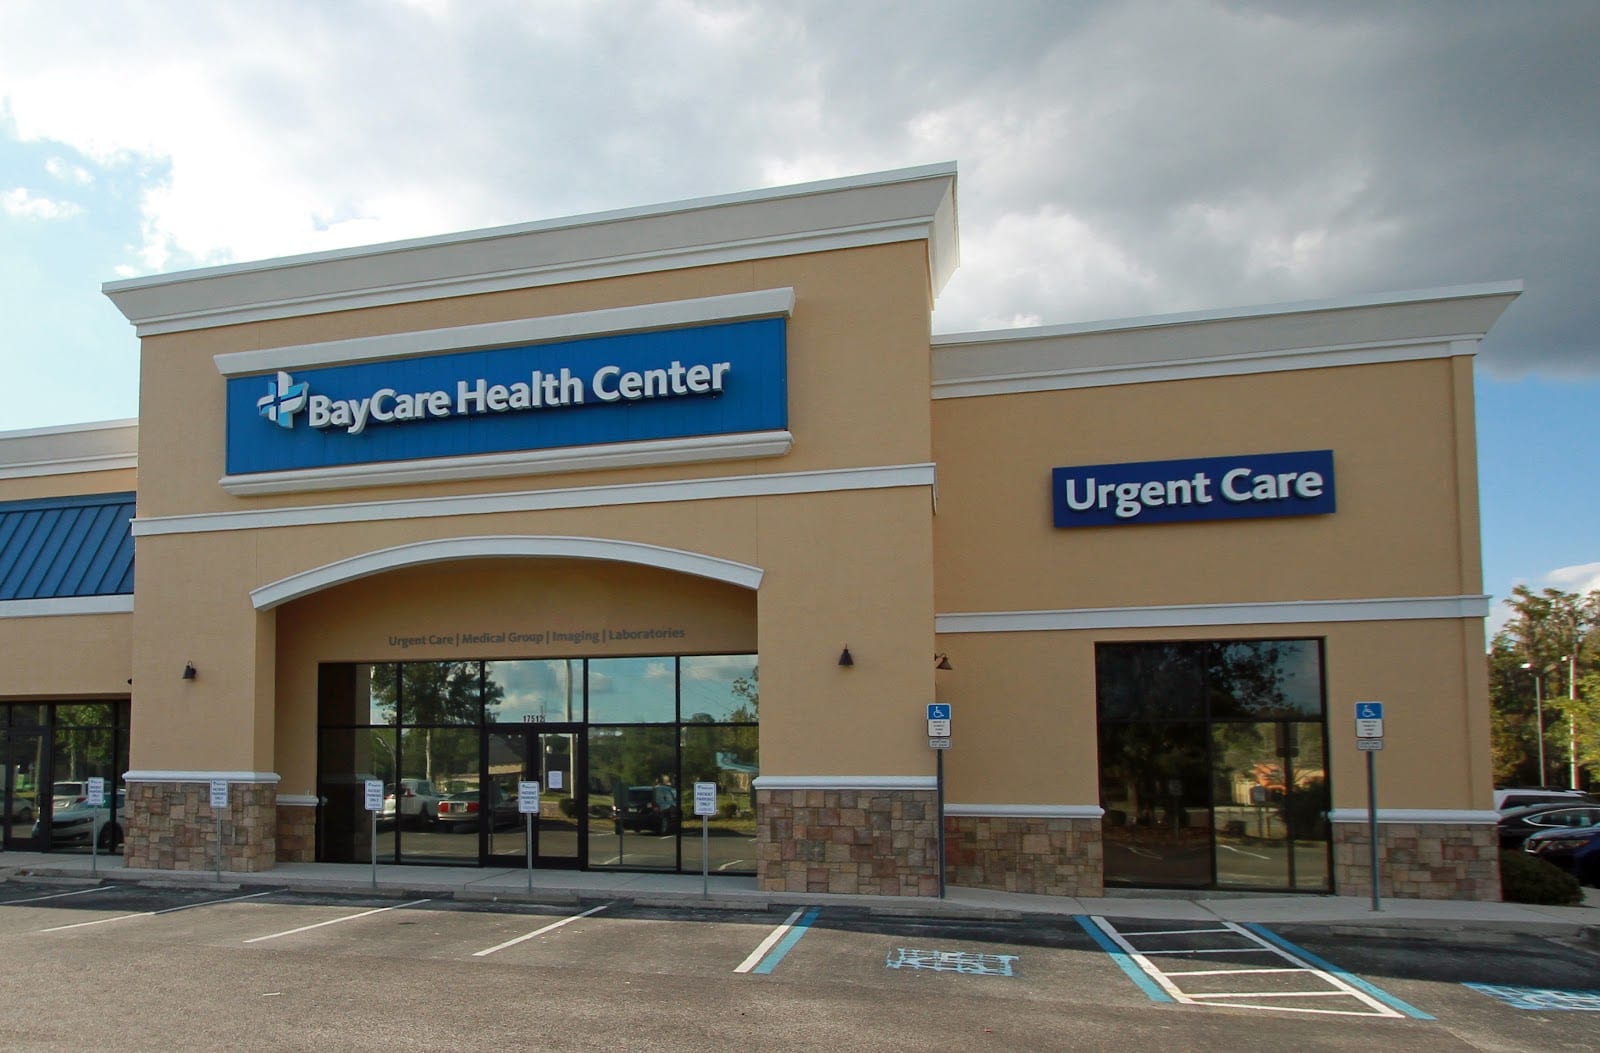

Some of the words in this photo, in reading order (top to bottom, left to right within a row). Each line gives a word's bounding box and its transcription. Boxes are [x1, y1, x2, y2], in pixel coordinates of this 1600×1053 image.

[308, 387, 451, 434] BayCare
[456, 367, 583, 415] Health
[592, 360, 730, 402] Center
[1066, 472, 1212, 518] Urgent
[1221, 467, 1323, 502] Care
[388, 635, 426, 648] Urgent
[428, 634, 454, 646] Care
[462, 632, 506, 644] Medical
[508, 632, 544, 645] Group
[552, 630, 600, 644] Imaging
[608, 627, 686, 641] Laboratories
[523, 715, 545, 723] 17512
